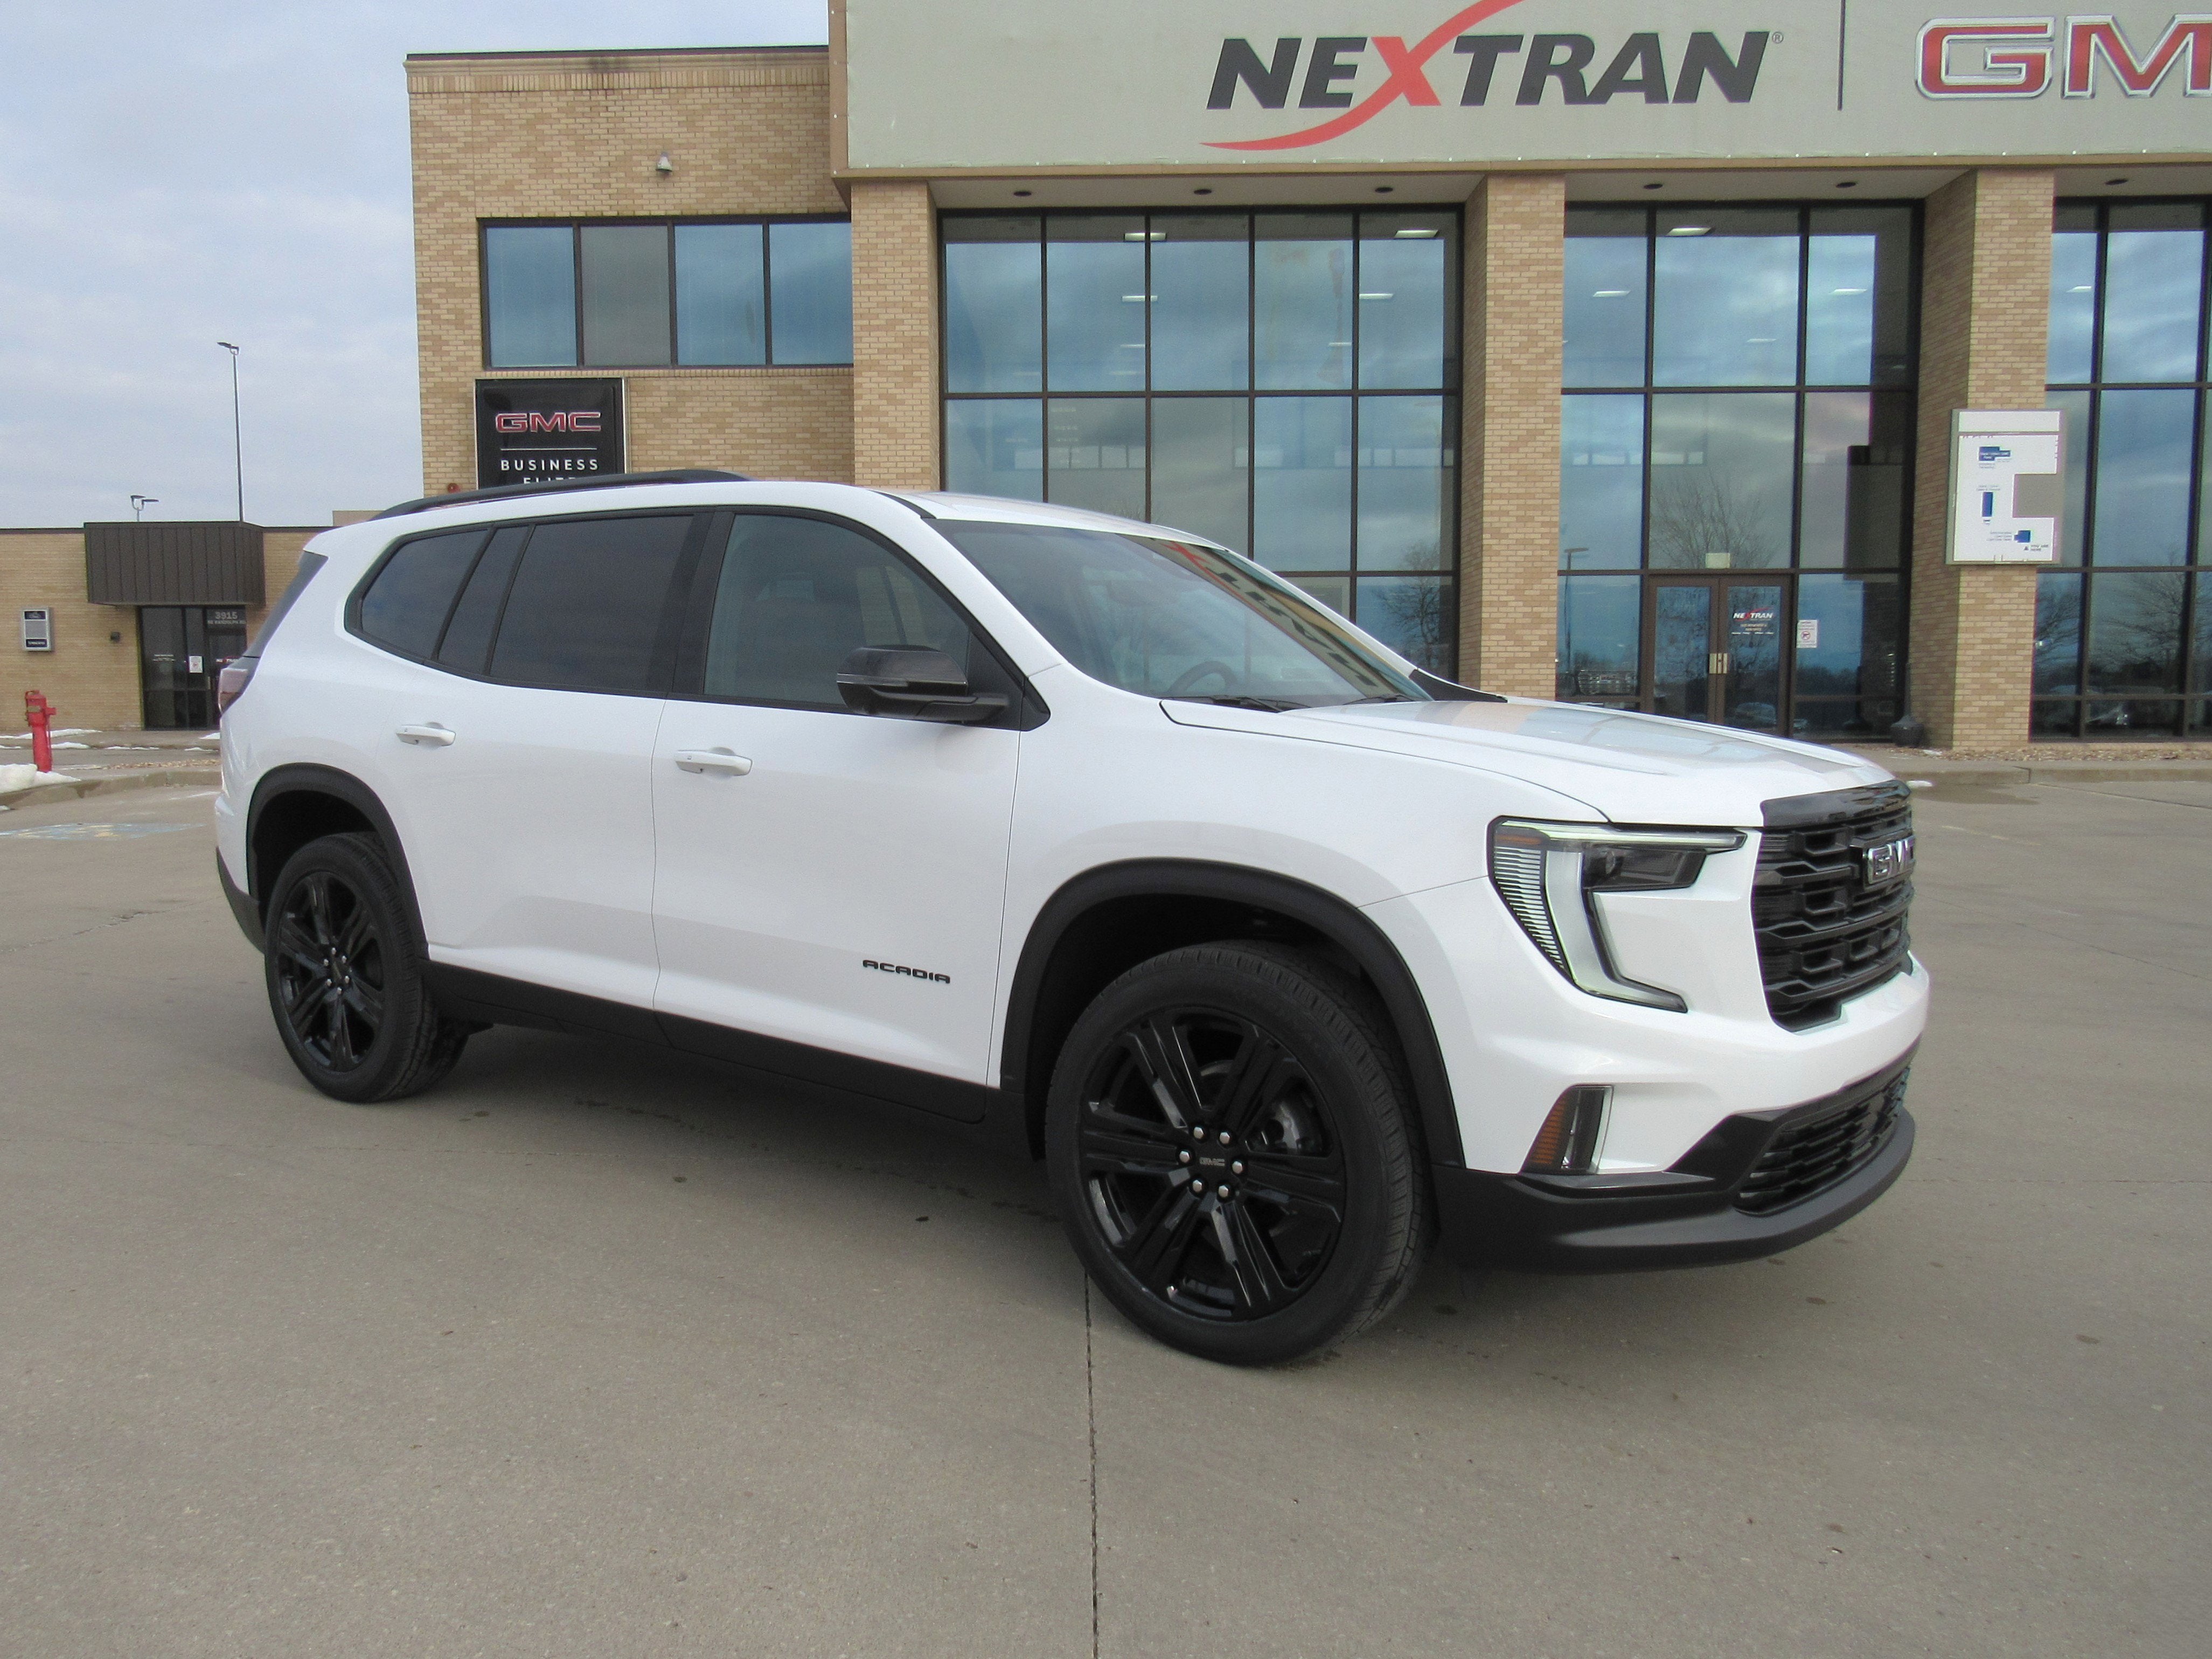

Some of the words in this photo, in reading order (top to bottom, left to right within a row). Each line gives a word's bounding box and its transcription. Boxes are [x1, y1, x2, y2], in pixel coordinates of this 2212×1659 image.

[495, 412, 602, 433] GMC
[500, 459, 599, 471] BUSINESS
[215, 611, 238, 619] 3915
[862, 959, 951, 985] ACADIA
[1199, 1156, 1226, 1167] GMC
